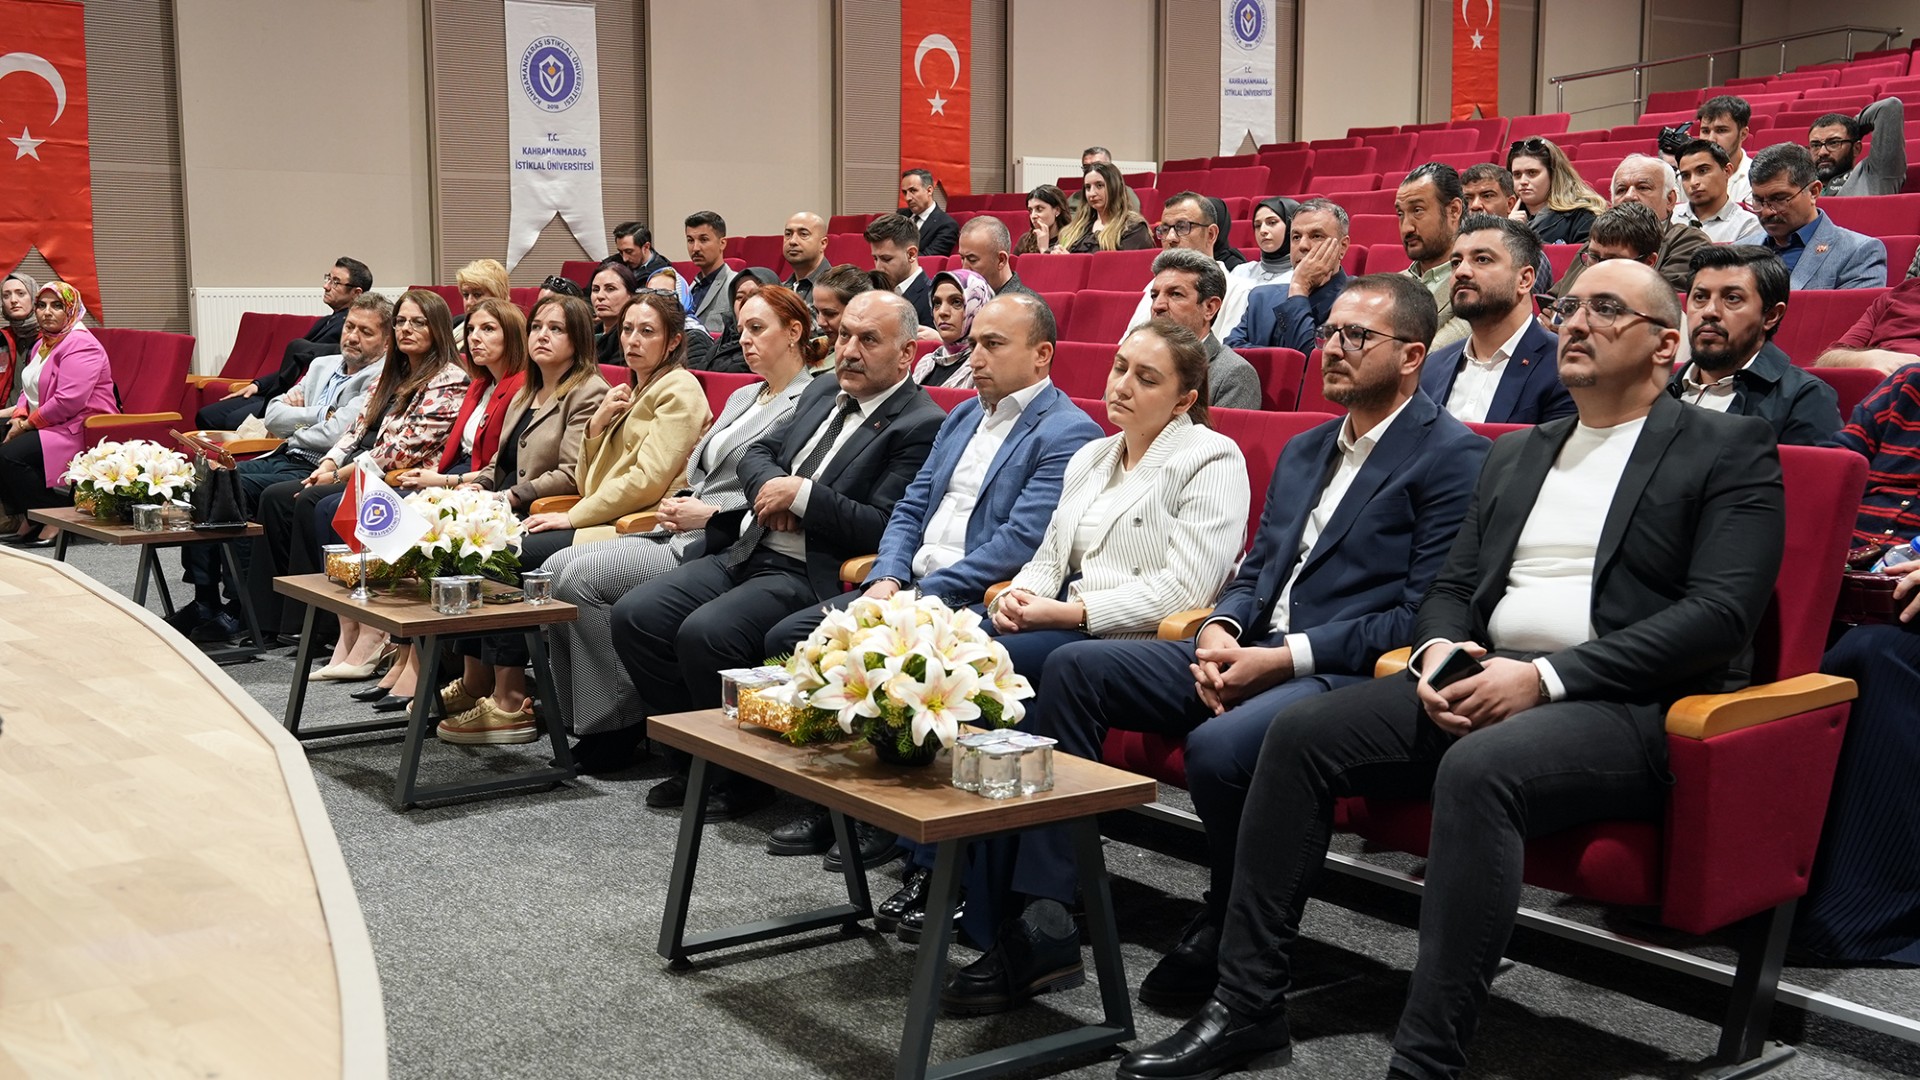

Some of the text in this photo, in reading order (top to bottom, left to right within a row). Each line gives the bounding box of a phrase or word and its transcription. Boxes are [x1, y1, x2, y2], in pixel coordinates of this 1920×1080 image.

[547, 133, 560, 142] T.C.
[522, 146, 587, 157] KAHRAMANMARAŞ
[515, 160, 594, 171] İSTİKLAL ÜNİVERSİTESİ
